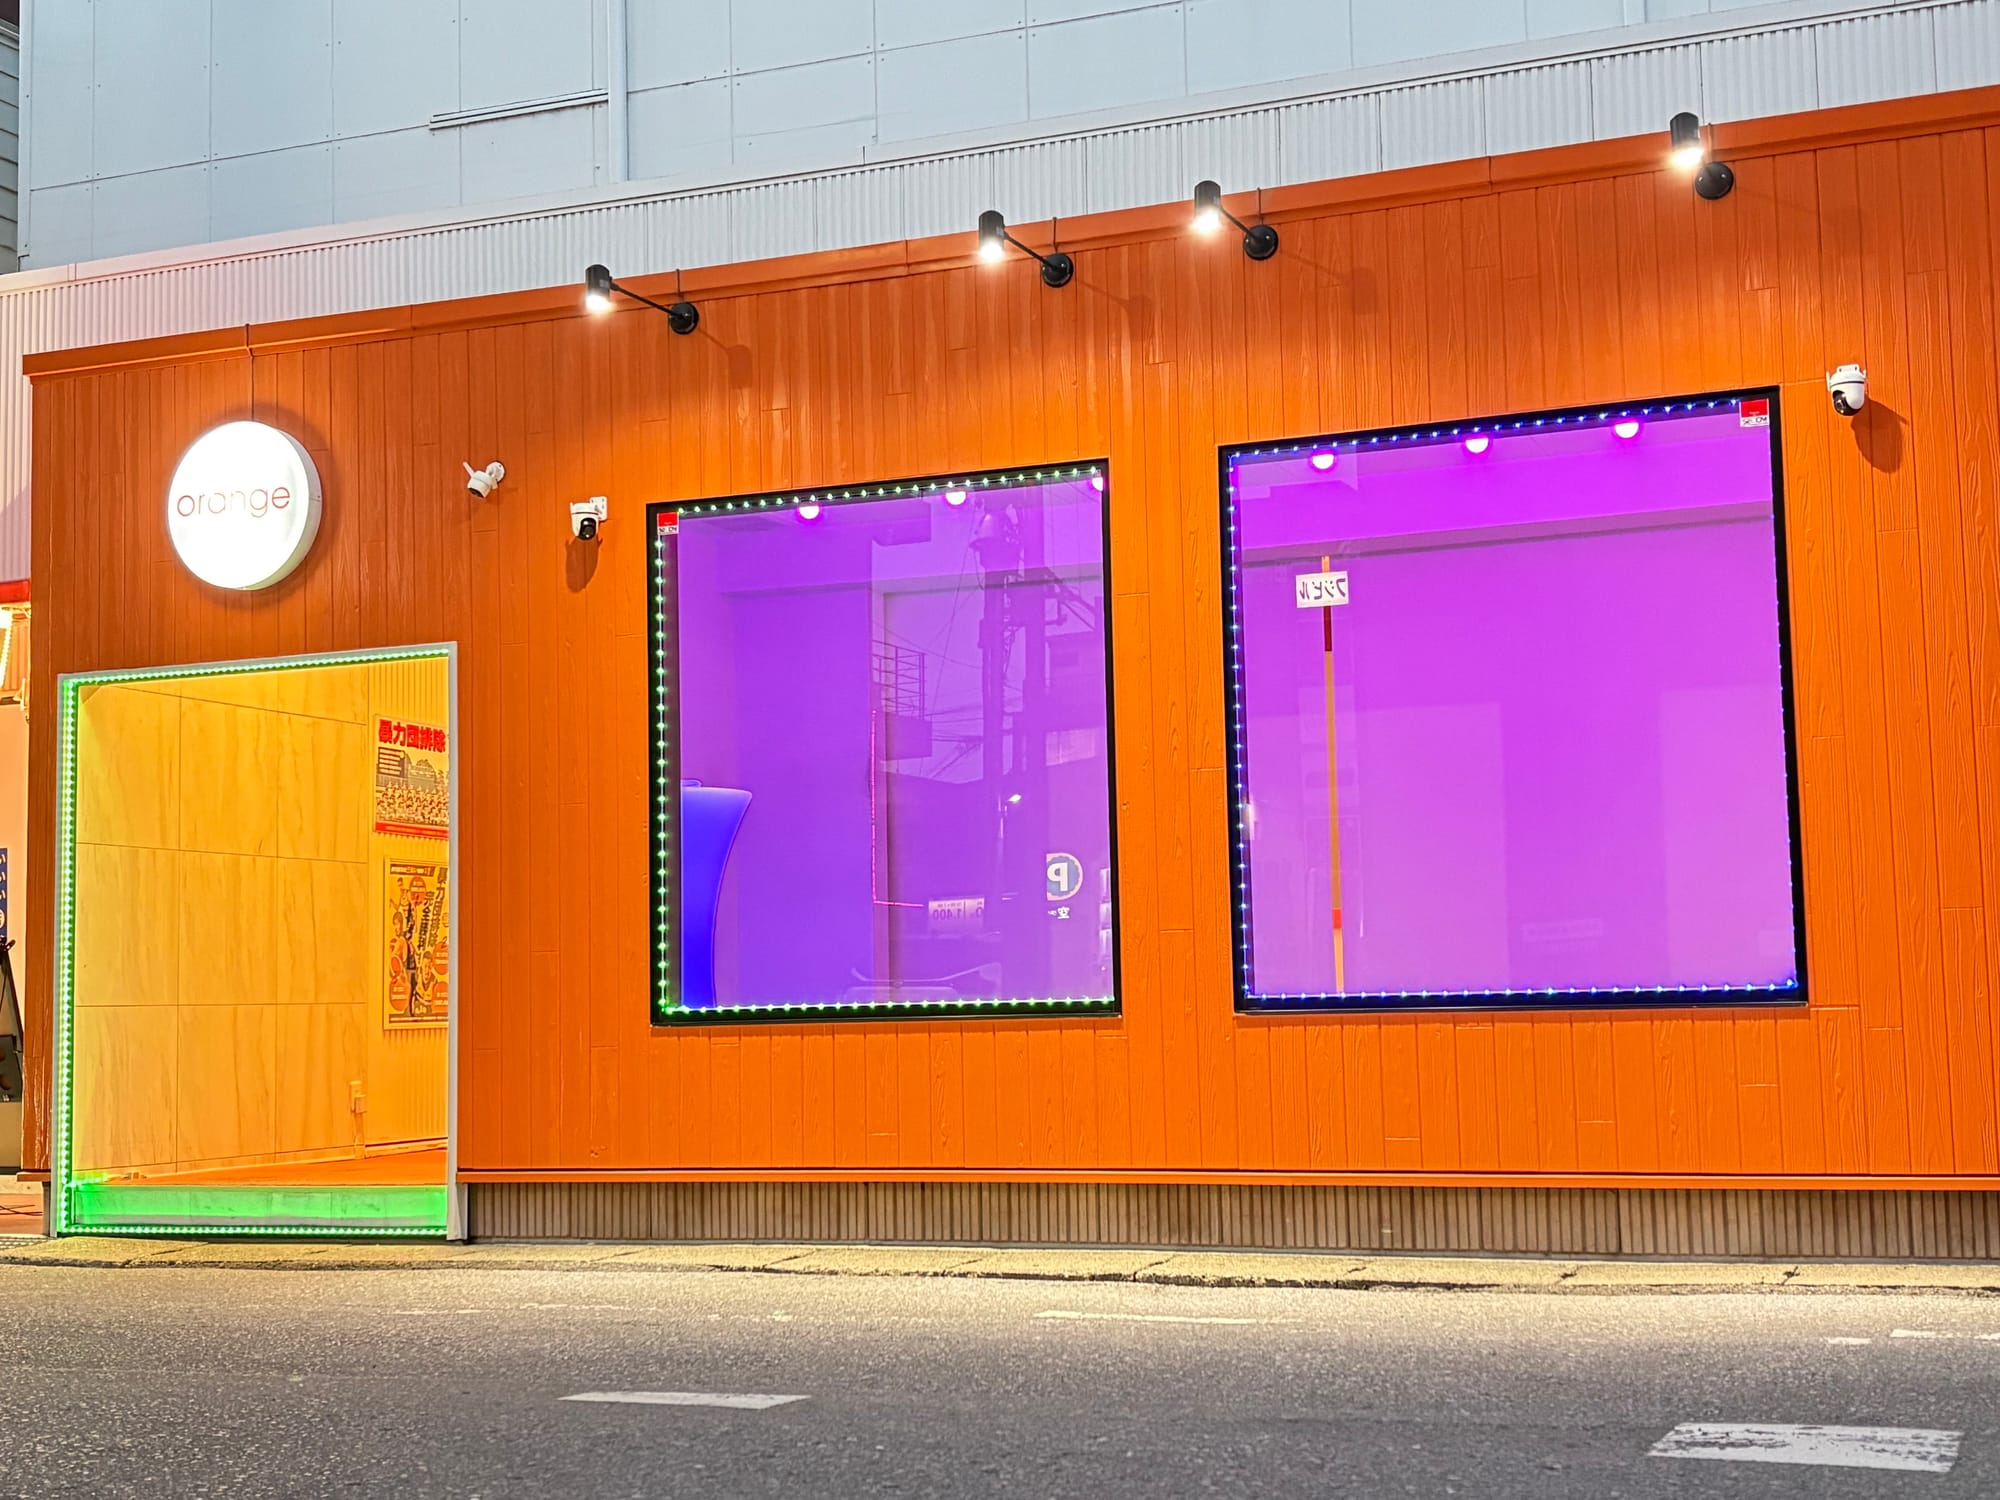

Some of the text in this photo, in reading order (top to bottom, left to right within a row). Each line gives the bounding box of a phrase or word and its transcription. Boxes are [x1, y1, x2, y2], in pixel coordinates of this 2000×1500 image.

[177, 487, 290, 518] orange
[378, 719, 446, 753] 暴力団排除
